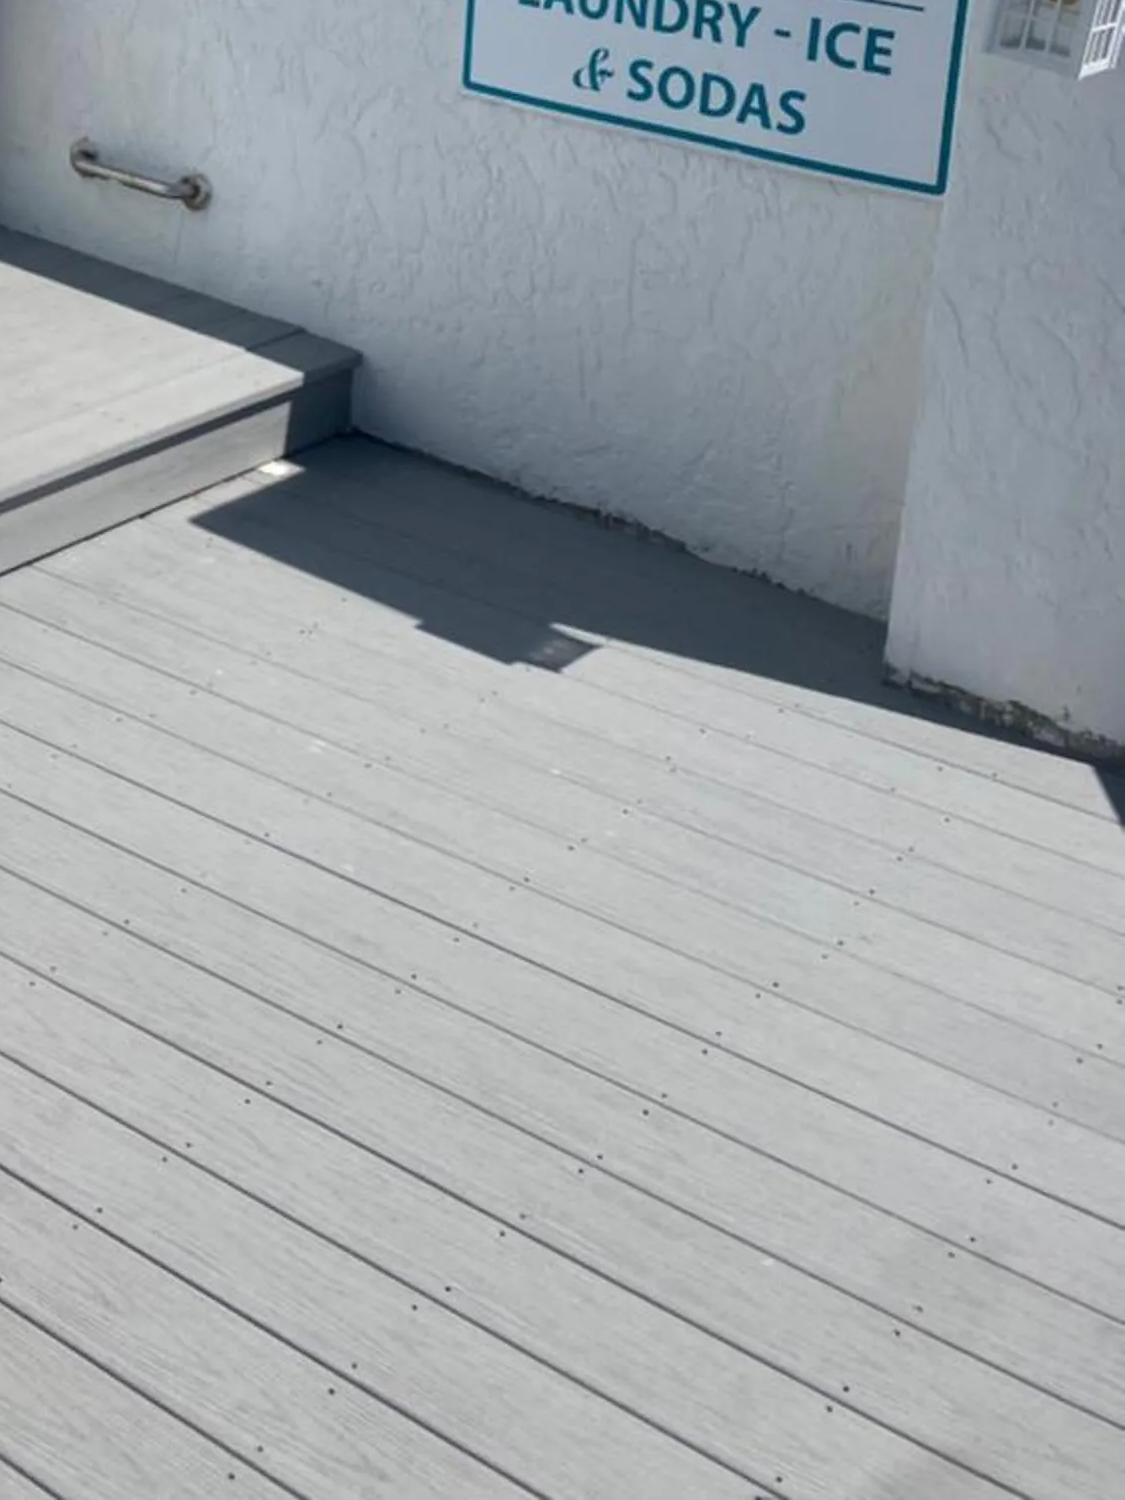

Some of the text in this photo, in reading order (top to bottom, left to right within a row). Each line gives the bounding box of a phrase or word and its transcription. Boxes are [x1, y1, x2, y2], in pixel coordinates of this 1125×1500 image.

[805, 16, 897, 77] ICE
[572, 47, 808, 136] & SODAS
